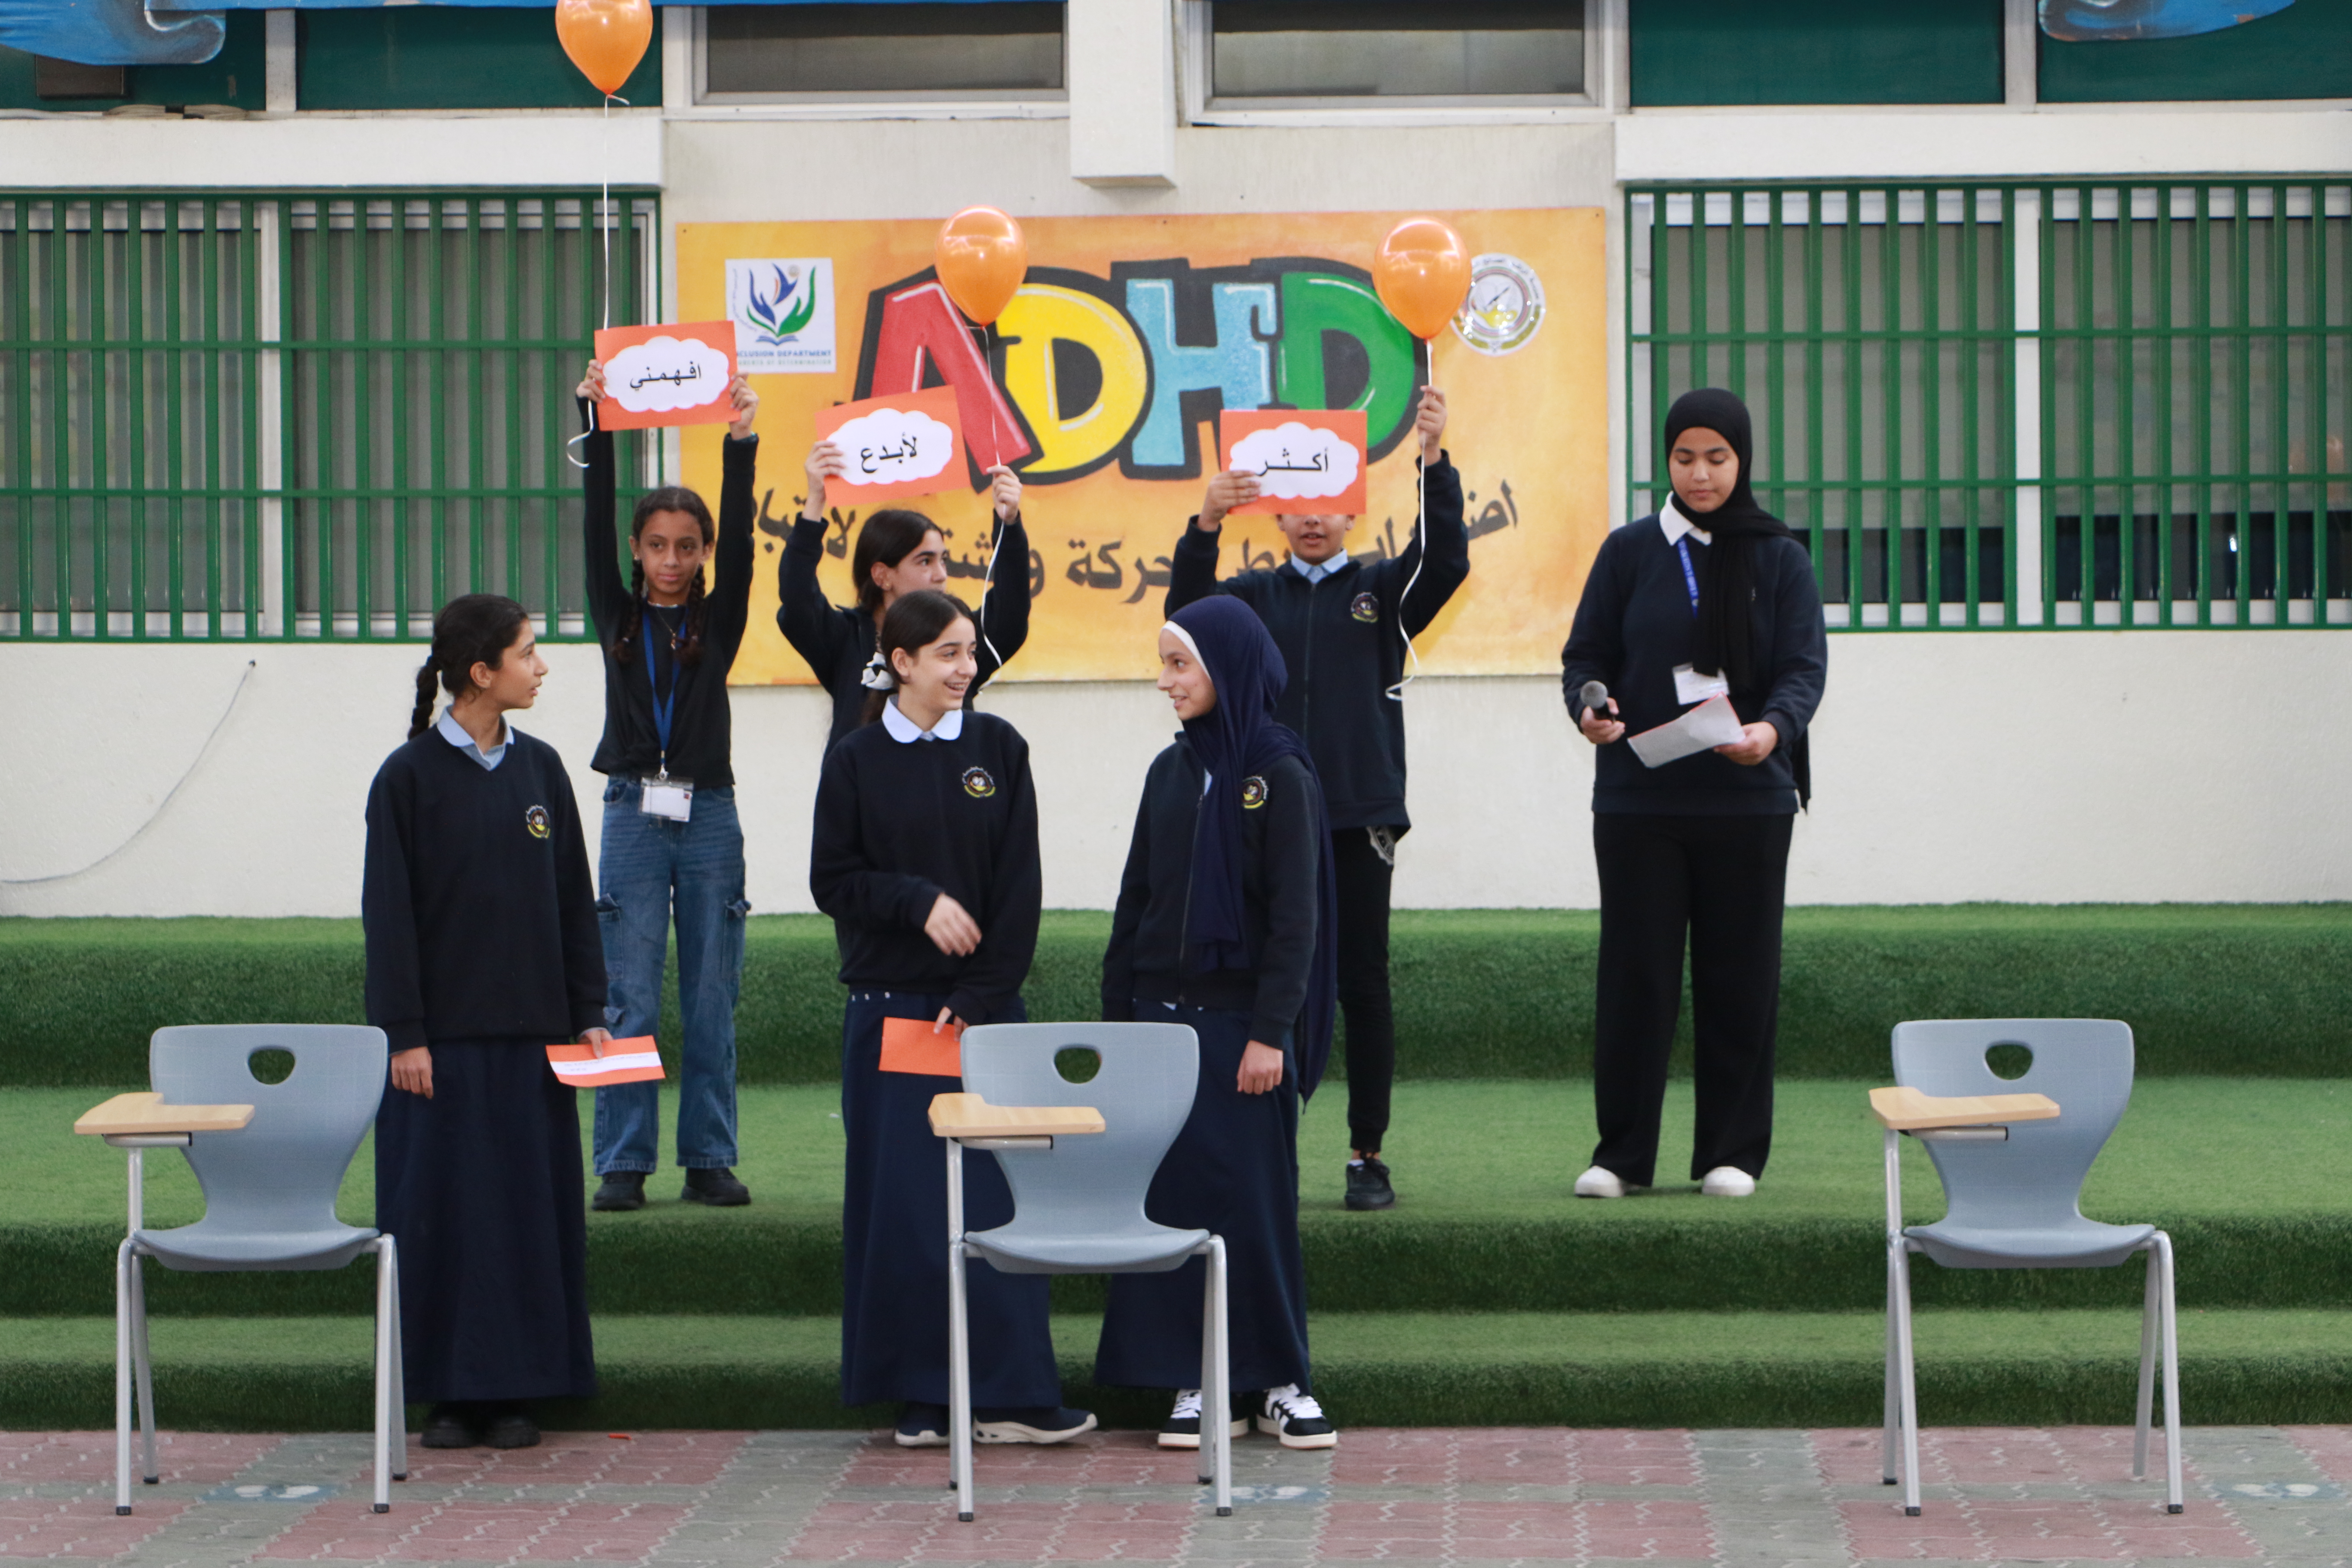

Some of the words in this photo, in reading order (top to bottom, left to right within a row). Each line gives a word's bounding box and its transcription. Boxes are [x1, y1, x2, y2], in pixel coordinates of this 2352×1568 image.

[629, 360, 701, 392] افهمني
[842, 257, 1430, 493] ADHD
[861, 431, 917, 473] لأبدع
[1256, 446, 1328, 476] أكثر
